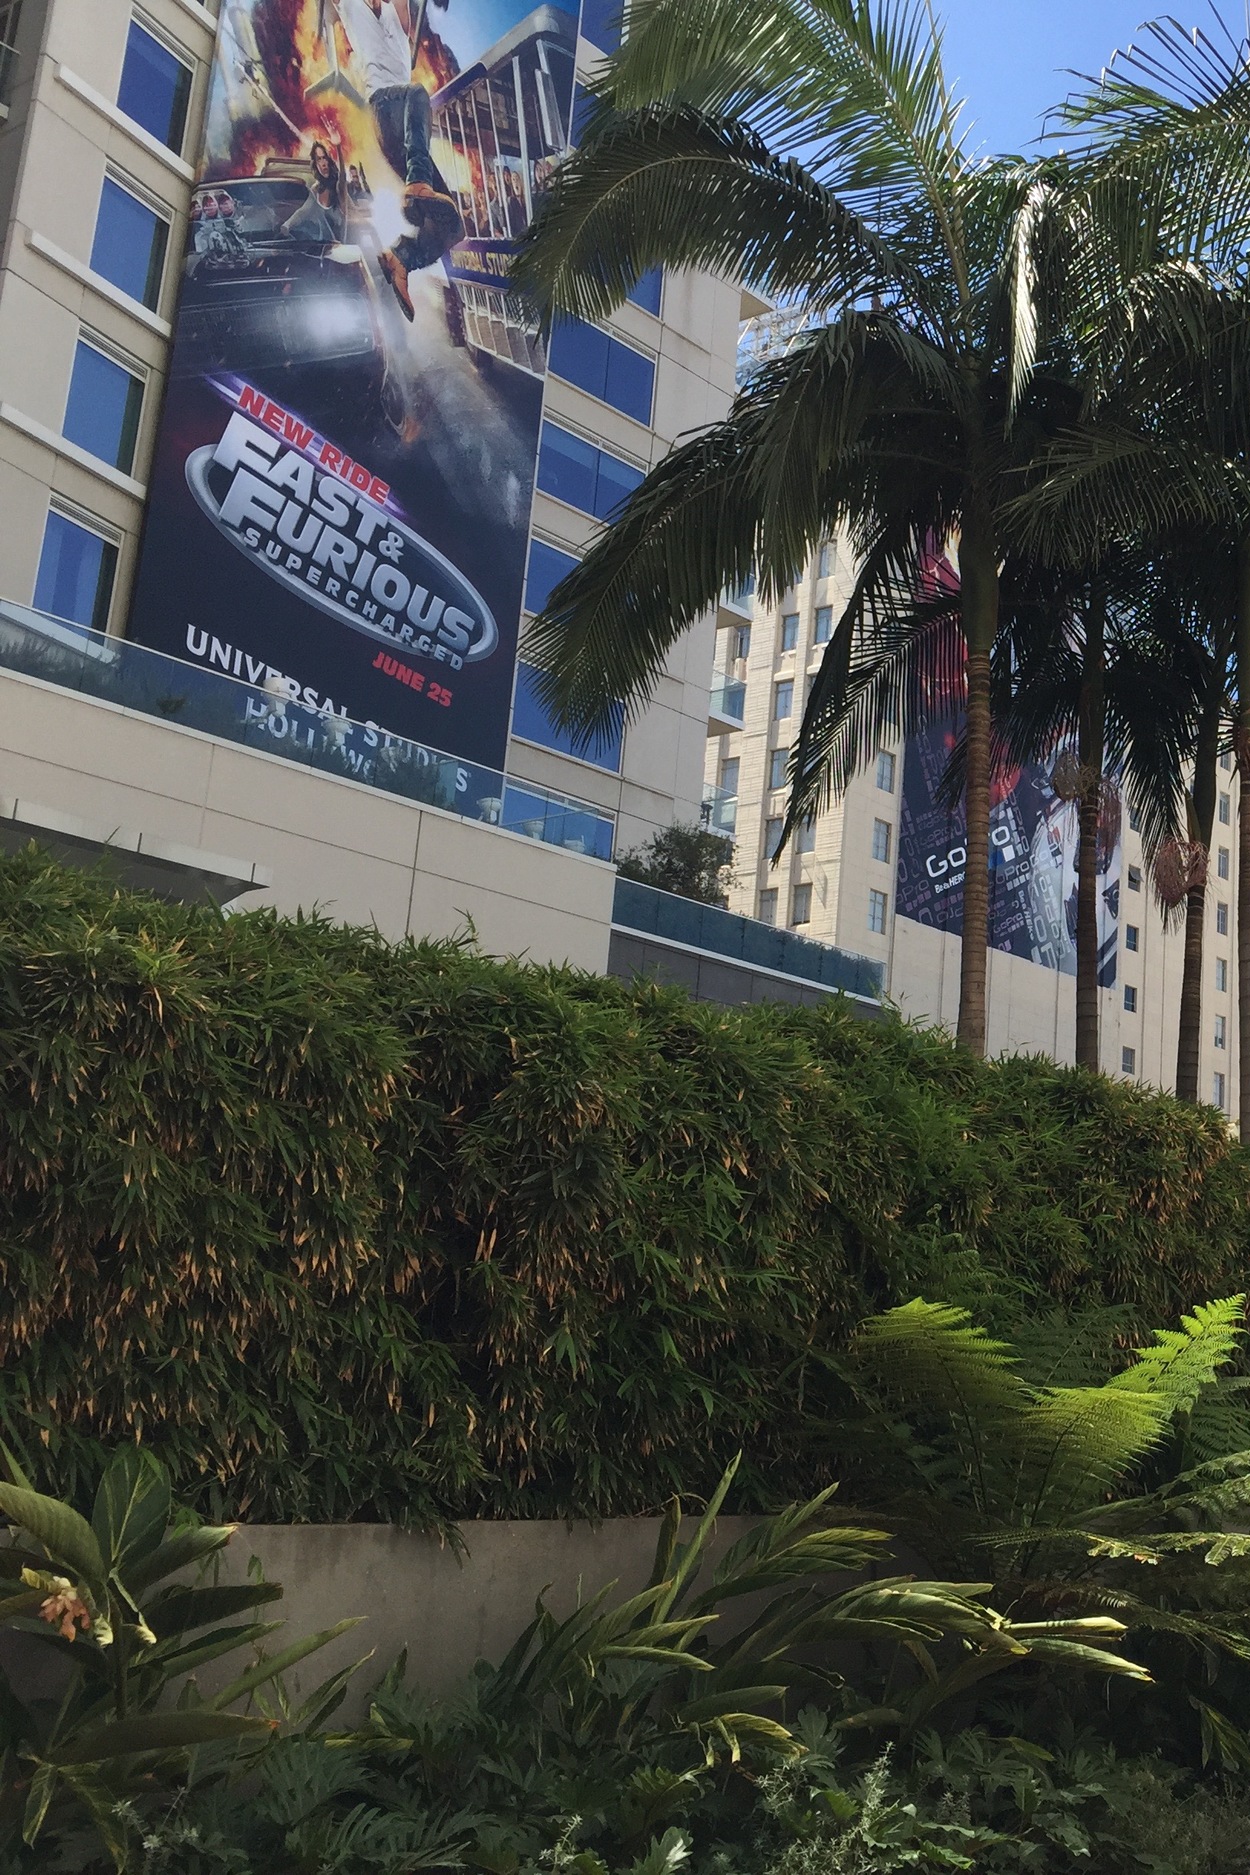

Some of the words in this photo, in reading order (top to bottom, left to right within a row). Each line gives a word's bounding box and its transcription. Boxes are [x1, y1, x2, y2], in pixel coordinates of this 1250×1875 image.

[213, 410, 388, 546] FAST
[378, 531, 404, 564] &
[238, 385, 313, 450] NEW
[318, 441, 390, 505] RIDE
[219, 467, 475, 651] FURIOUS
[243, 527, 464, 671] SUPERCHARGED
[372, 651, 426, 691] JUNE
[427, 681, 454, 708] 25
[926, 826, 1010, 878] Goo
